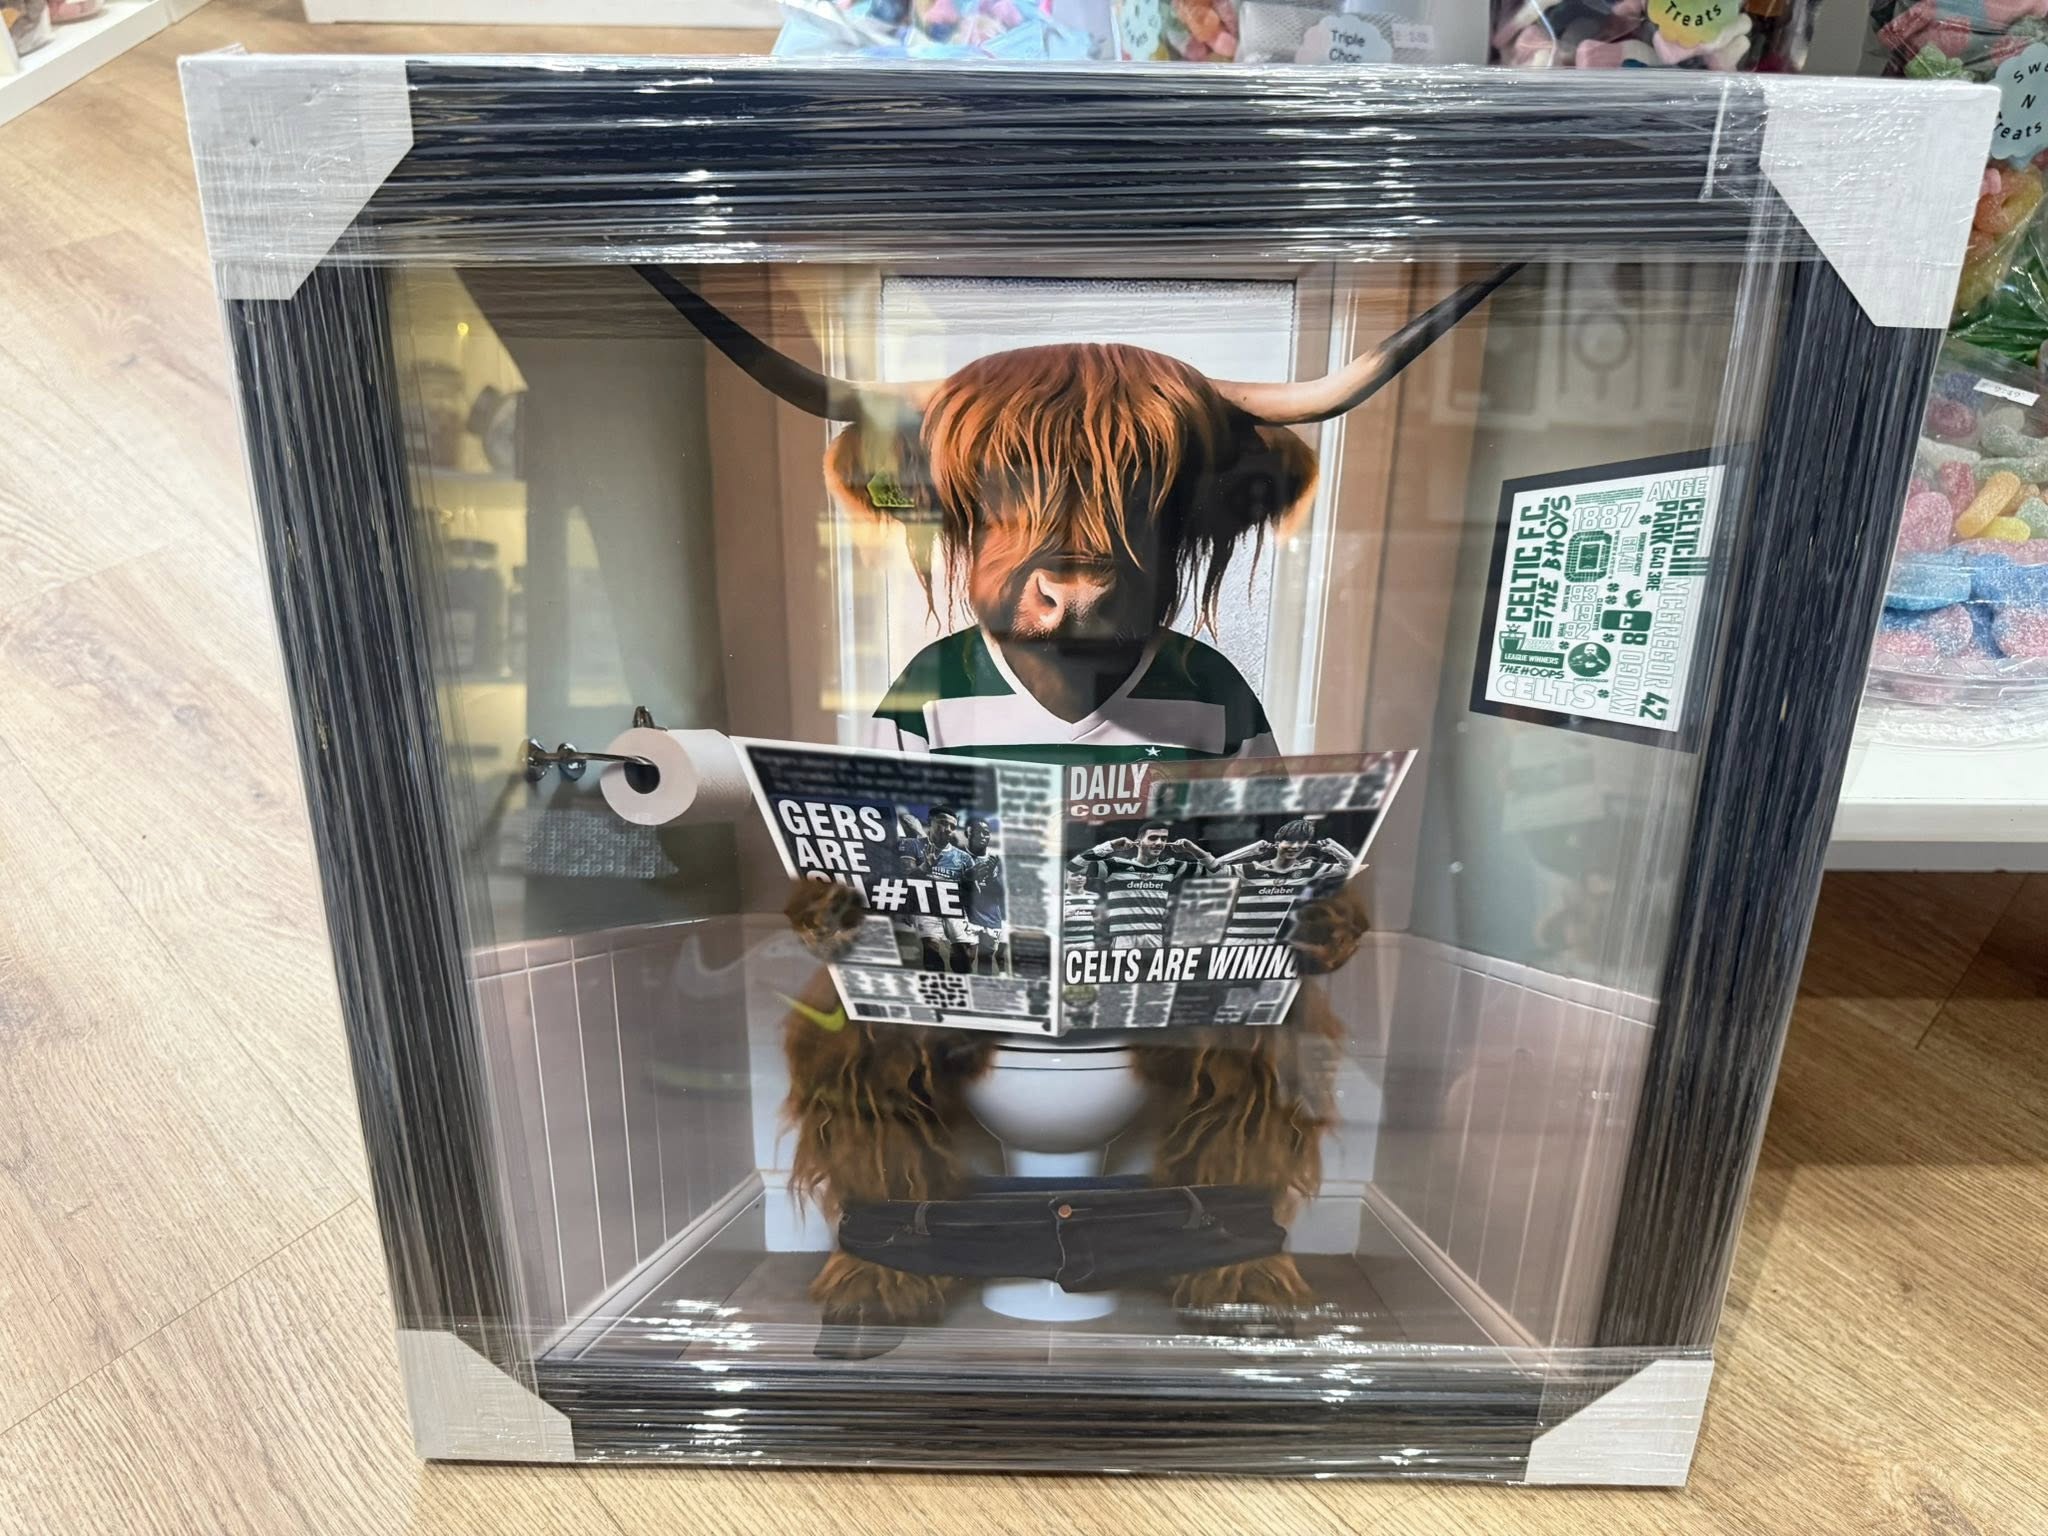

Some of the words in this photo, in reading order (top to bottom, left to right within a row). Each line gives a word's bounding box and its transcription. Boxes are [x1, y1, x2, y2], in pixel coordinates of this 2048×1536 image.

[1665, 0, 1721, 26] Treats
[1330, 29, 1365, 47] Triple
[2021, 94, 2036, 109] N
[1993, 111, 2042, 140] reats
[1647, 476, 1709, 502] ANGE
[1517, 497, 1551, 540] F.C.
[1572, 501, 1640, 531] 1887
[1649, 500, 1680, 546] PARK
[1672, 498, 1706, 556] CELTIC
[1541, 495, 1571, 571] BHOYS
[1649, 547, 1666, 569] G40
[1505, 546, 1542, 622] CELTIC
[1570, 584, 1599, 603] 93
[1646, 571, 1662, 592] 3RE
[1534, 577, 1559, 618] THE
[1573, 603, 1595, 622] 19
[1563, 622, 1591, 640] 92
[1621, 632, 1648, 646] 8
[1643, 577, 1691, 689] MCGREGOR
[1504, 652, 1527, 662] LEAGUE
[1528, 653, 1560, 665] WINNERS
[1495, 674, 1598, 710] CELTS
[1609, 649, 1645, 716] KYOGO
[1638, 691, 1669, 721] 42
[1070, 763, 1149, 801] DAILY
[778, 799, 886, 843] GERS
[796, 836, 871, 873] ARE
[805, 870, 963, 917] #TE
[1126, 880, 1164, 889] dafabet
[1258, 887, 1294, 895] dafabet
[1065, 948, 1140, 984] CELTS
[1145, 946, 1202, 982] ARE
